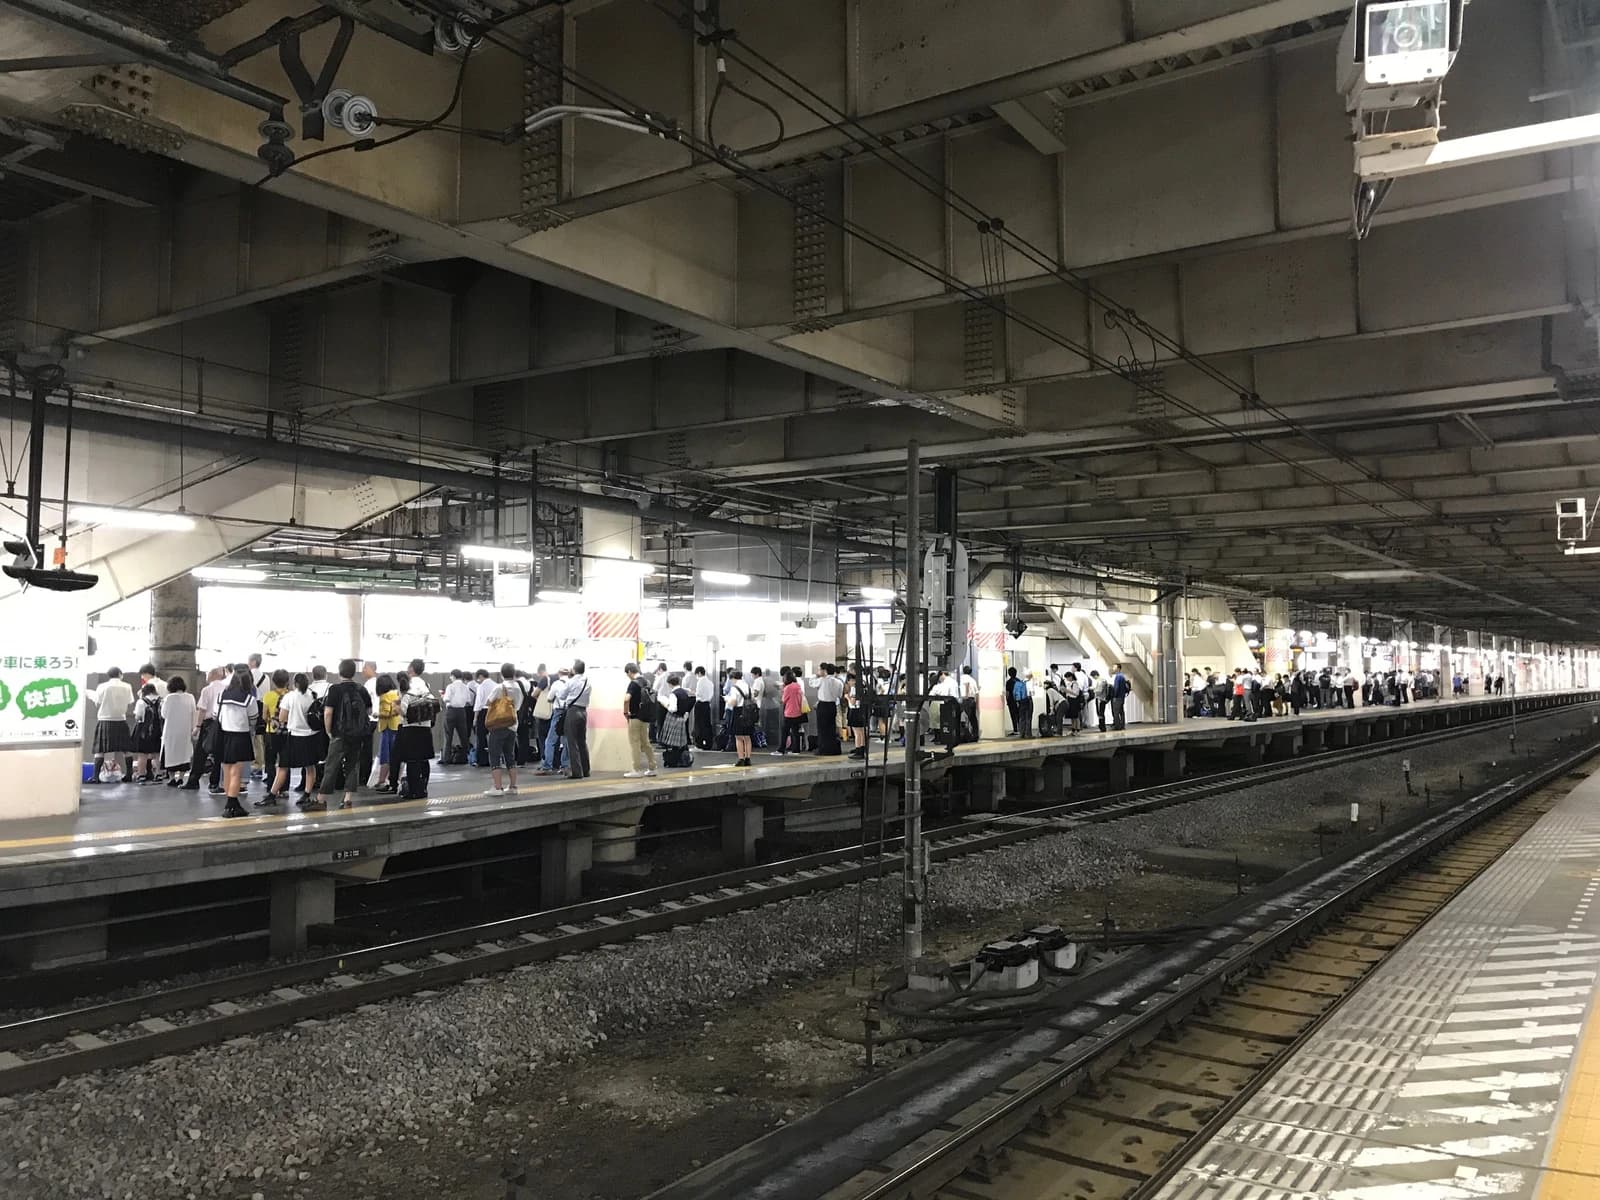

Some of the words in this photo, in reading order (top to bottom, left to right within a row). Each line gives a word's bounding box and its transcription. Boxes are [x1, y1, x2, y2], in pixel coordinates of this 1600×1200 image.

[0, 656, 79, 669] 車に乗ろう!
